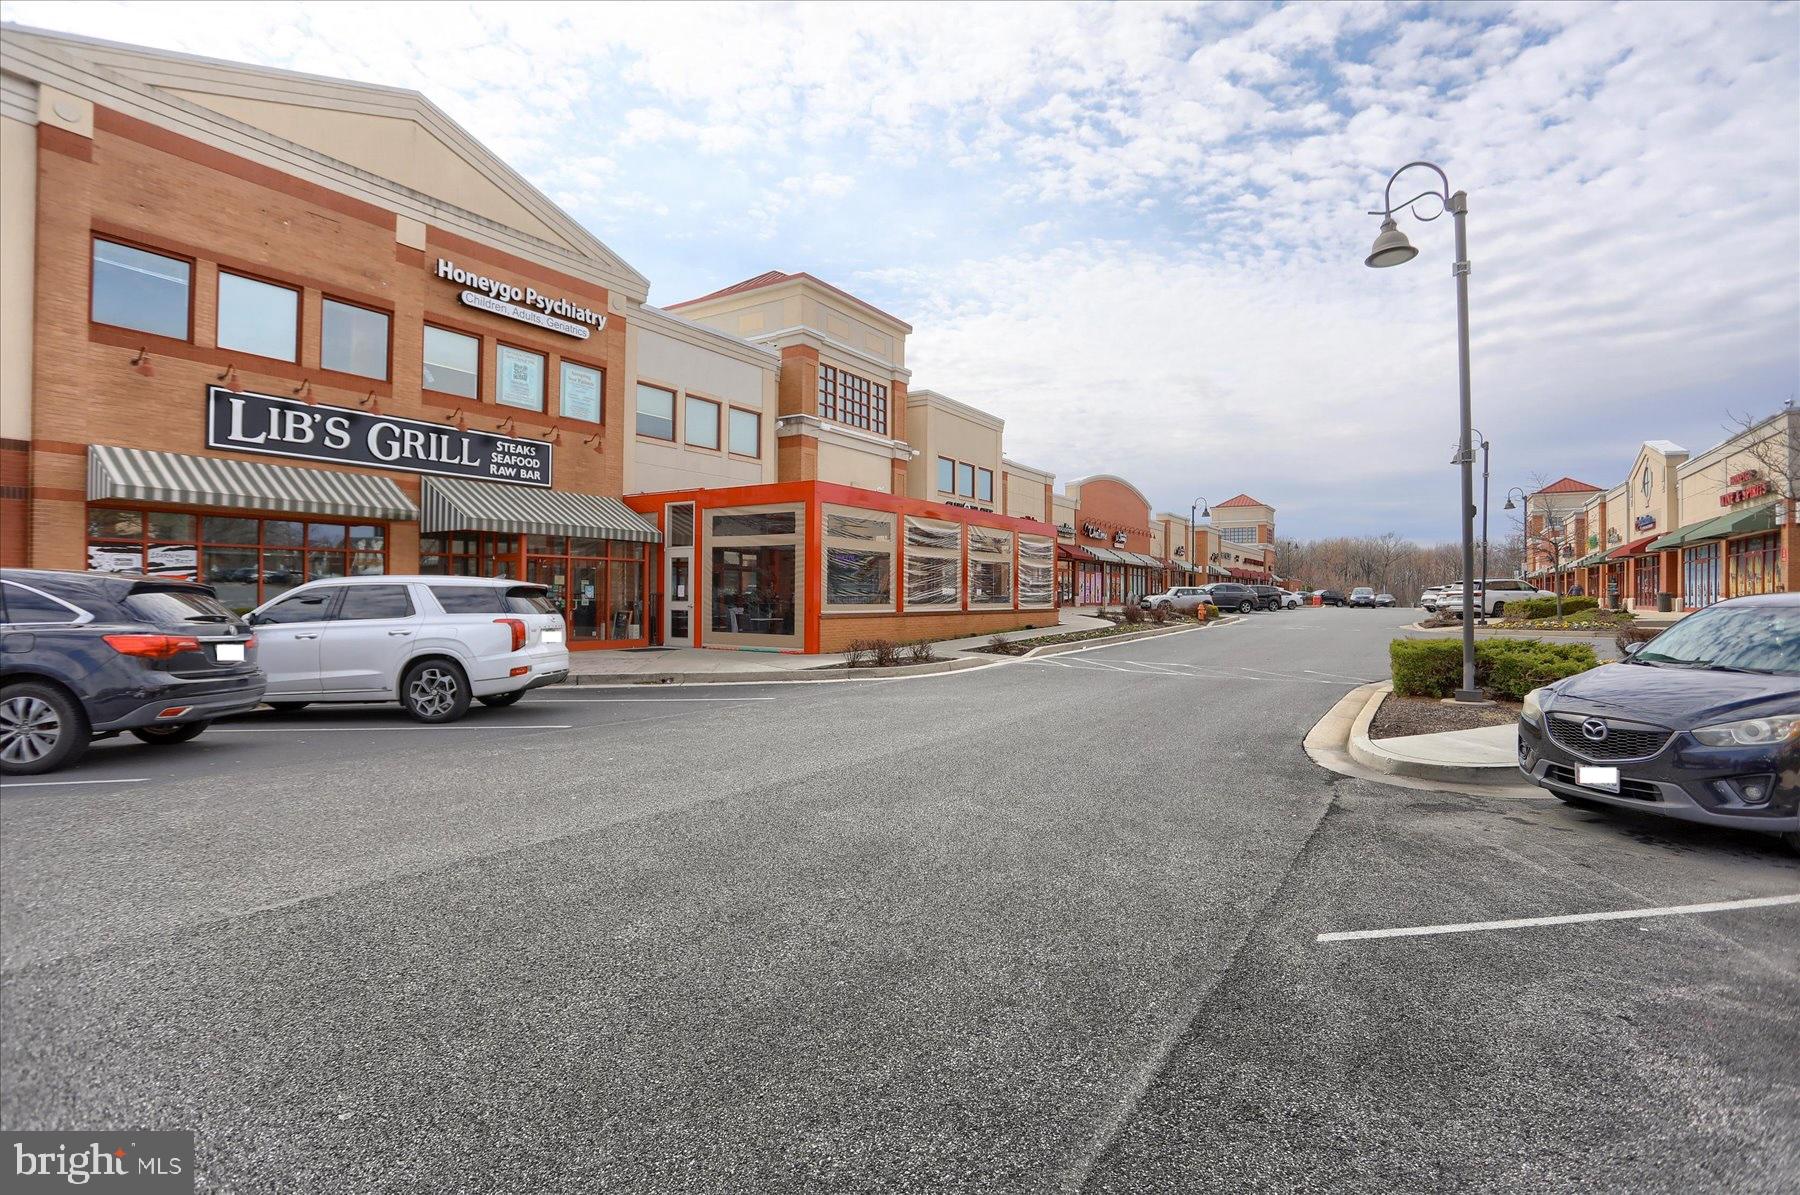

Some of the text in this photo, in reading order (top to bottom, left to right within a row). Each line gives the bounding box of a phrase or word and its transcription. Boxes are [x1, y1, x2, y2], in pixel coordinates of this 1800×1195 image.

[437, 258, 607, 330] Honeygo Psychiatry
[465, 292, 587, 337] Children, Adults, Geriatrics
[367, 422, 481, 467] GRILL
[496, 441, 536, 456] STEAKS
[489, 464, 541, 480] RAW BAR
[491, 452, 541, 468] SEAFOOD
